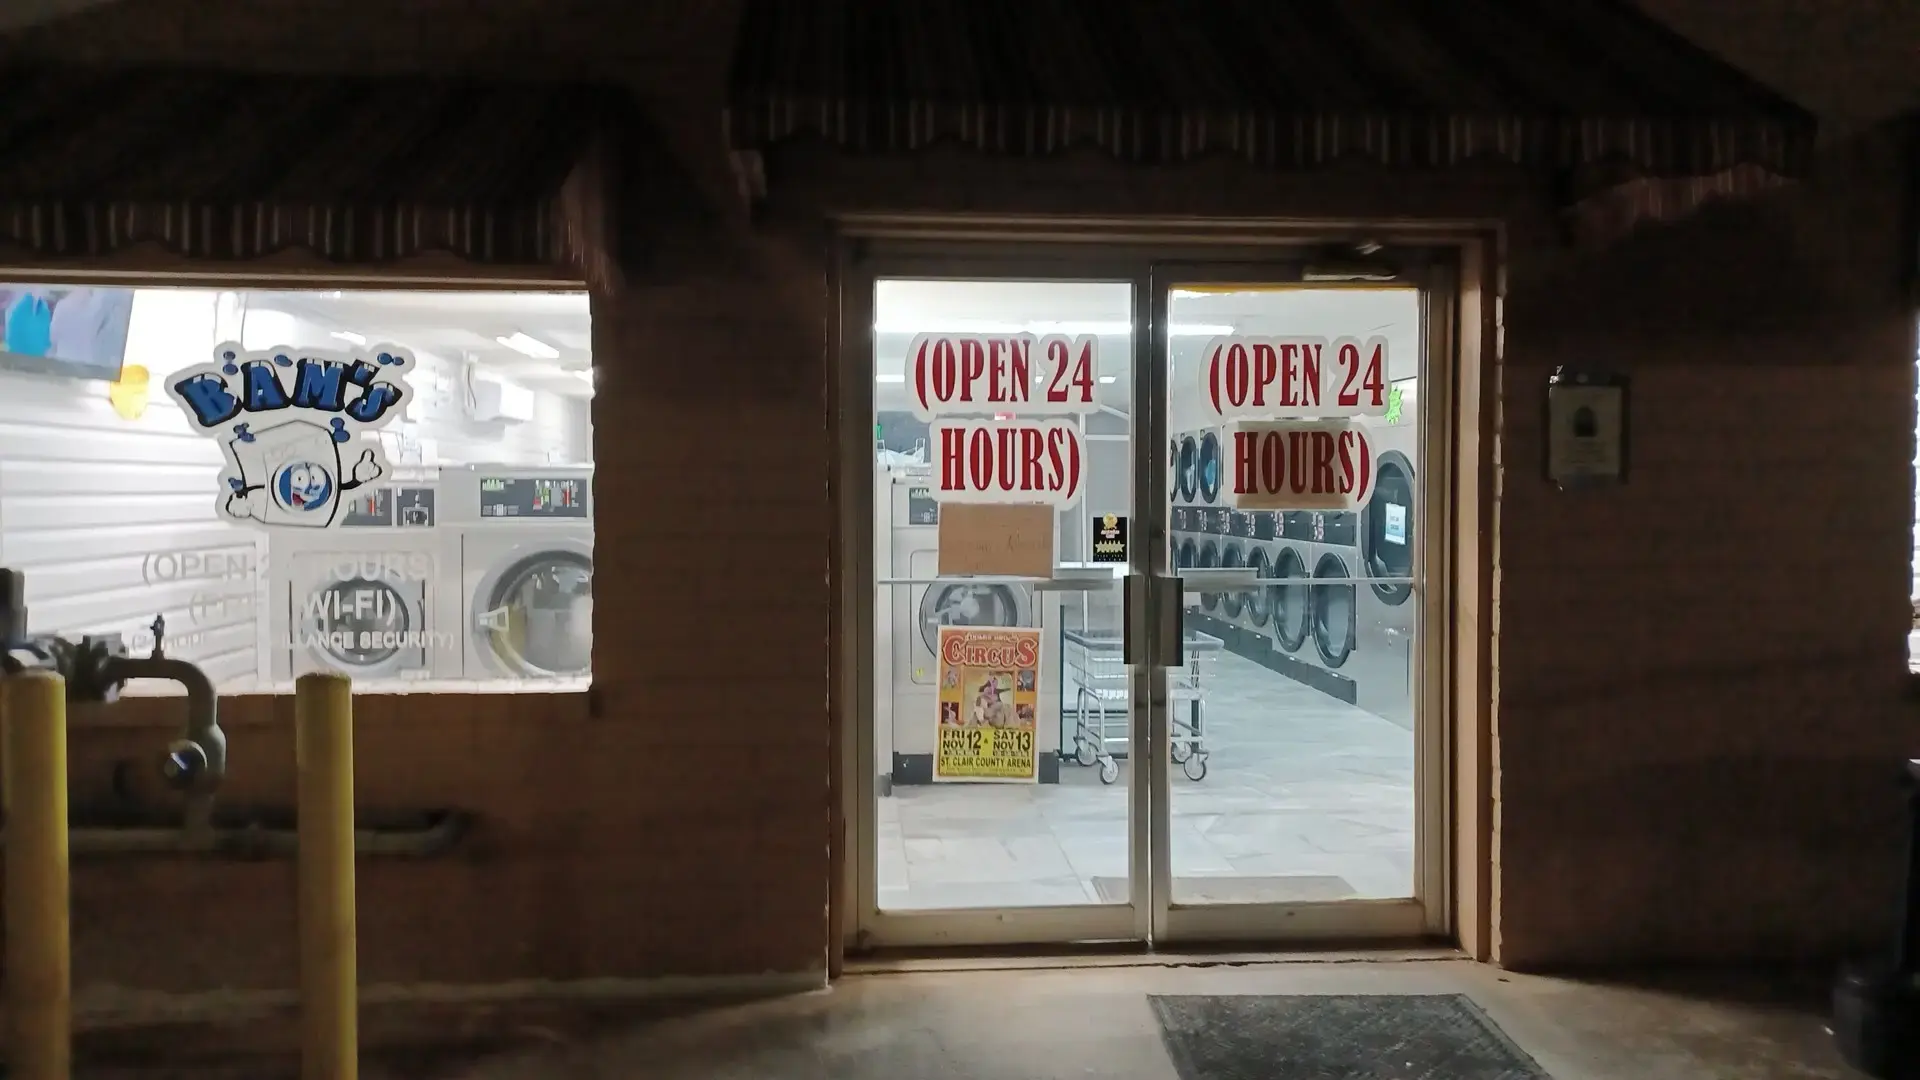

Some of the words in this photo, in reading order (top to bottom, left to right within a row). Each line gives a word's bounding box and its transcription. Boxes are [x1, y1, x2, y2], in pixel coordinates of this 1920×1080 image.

[915, 338, 1030, 410] (OPEN
[1047, 340, 1094, 402] 24
[1209, 343, 1323, 416] (OPEN
[1338, 343, 1385, 407] 24
[174, 357, 403, 427] BAM'S
[940, 427, 1081, 500] HOURS)
[1233, 430, 1371, 502] HOURS)
[141, 552, 247, 586] (OPEN
[302, 588, 397, 626] WI-FI)
[942, 634, 1038, 668] CIRCUS
[942, 740, 965, 749] NOV
[943, 730, 965, 739] FRI
[966, 730, 982, 749] 12
[993, 731, 1015, 740] SAT
[993, 741, 1015, 750] NOV
[1016, 732, 1031, 751] 13
[953, 757, 974, 768] CLAIR
[975, 758, 1004, 768] COUNTY
[1007, 758, 1031, 768] ARENA
